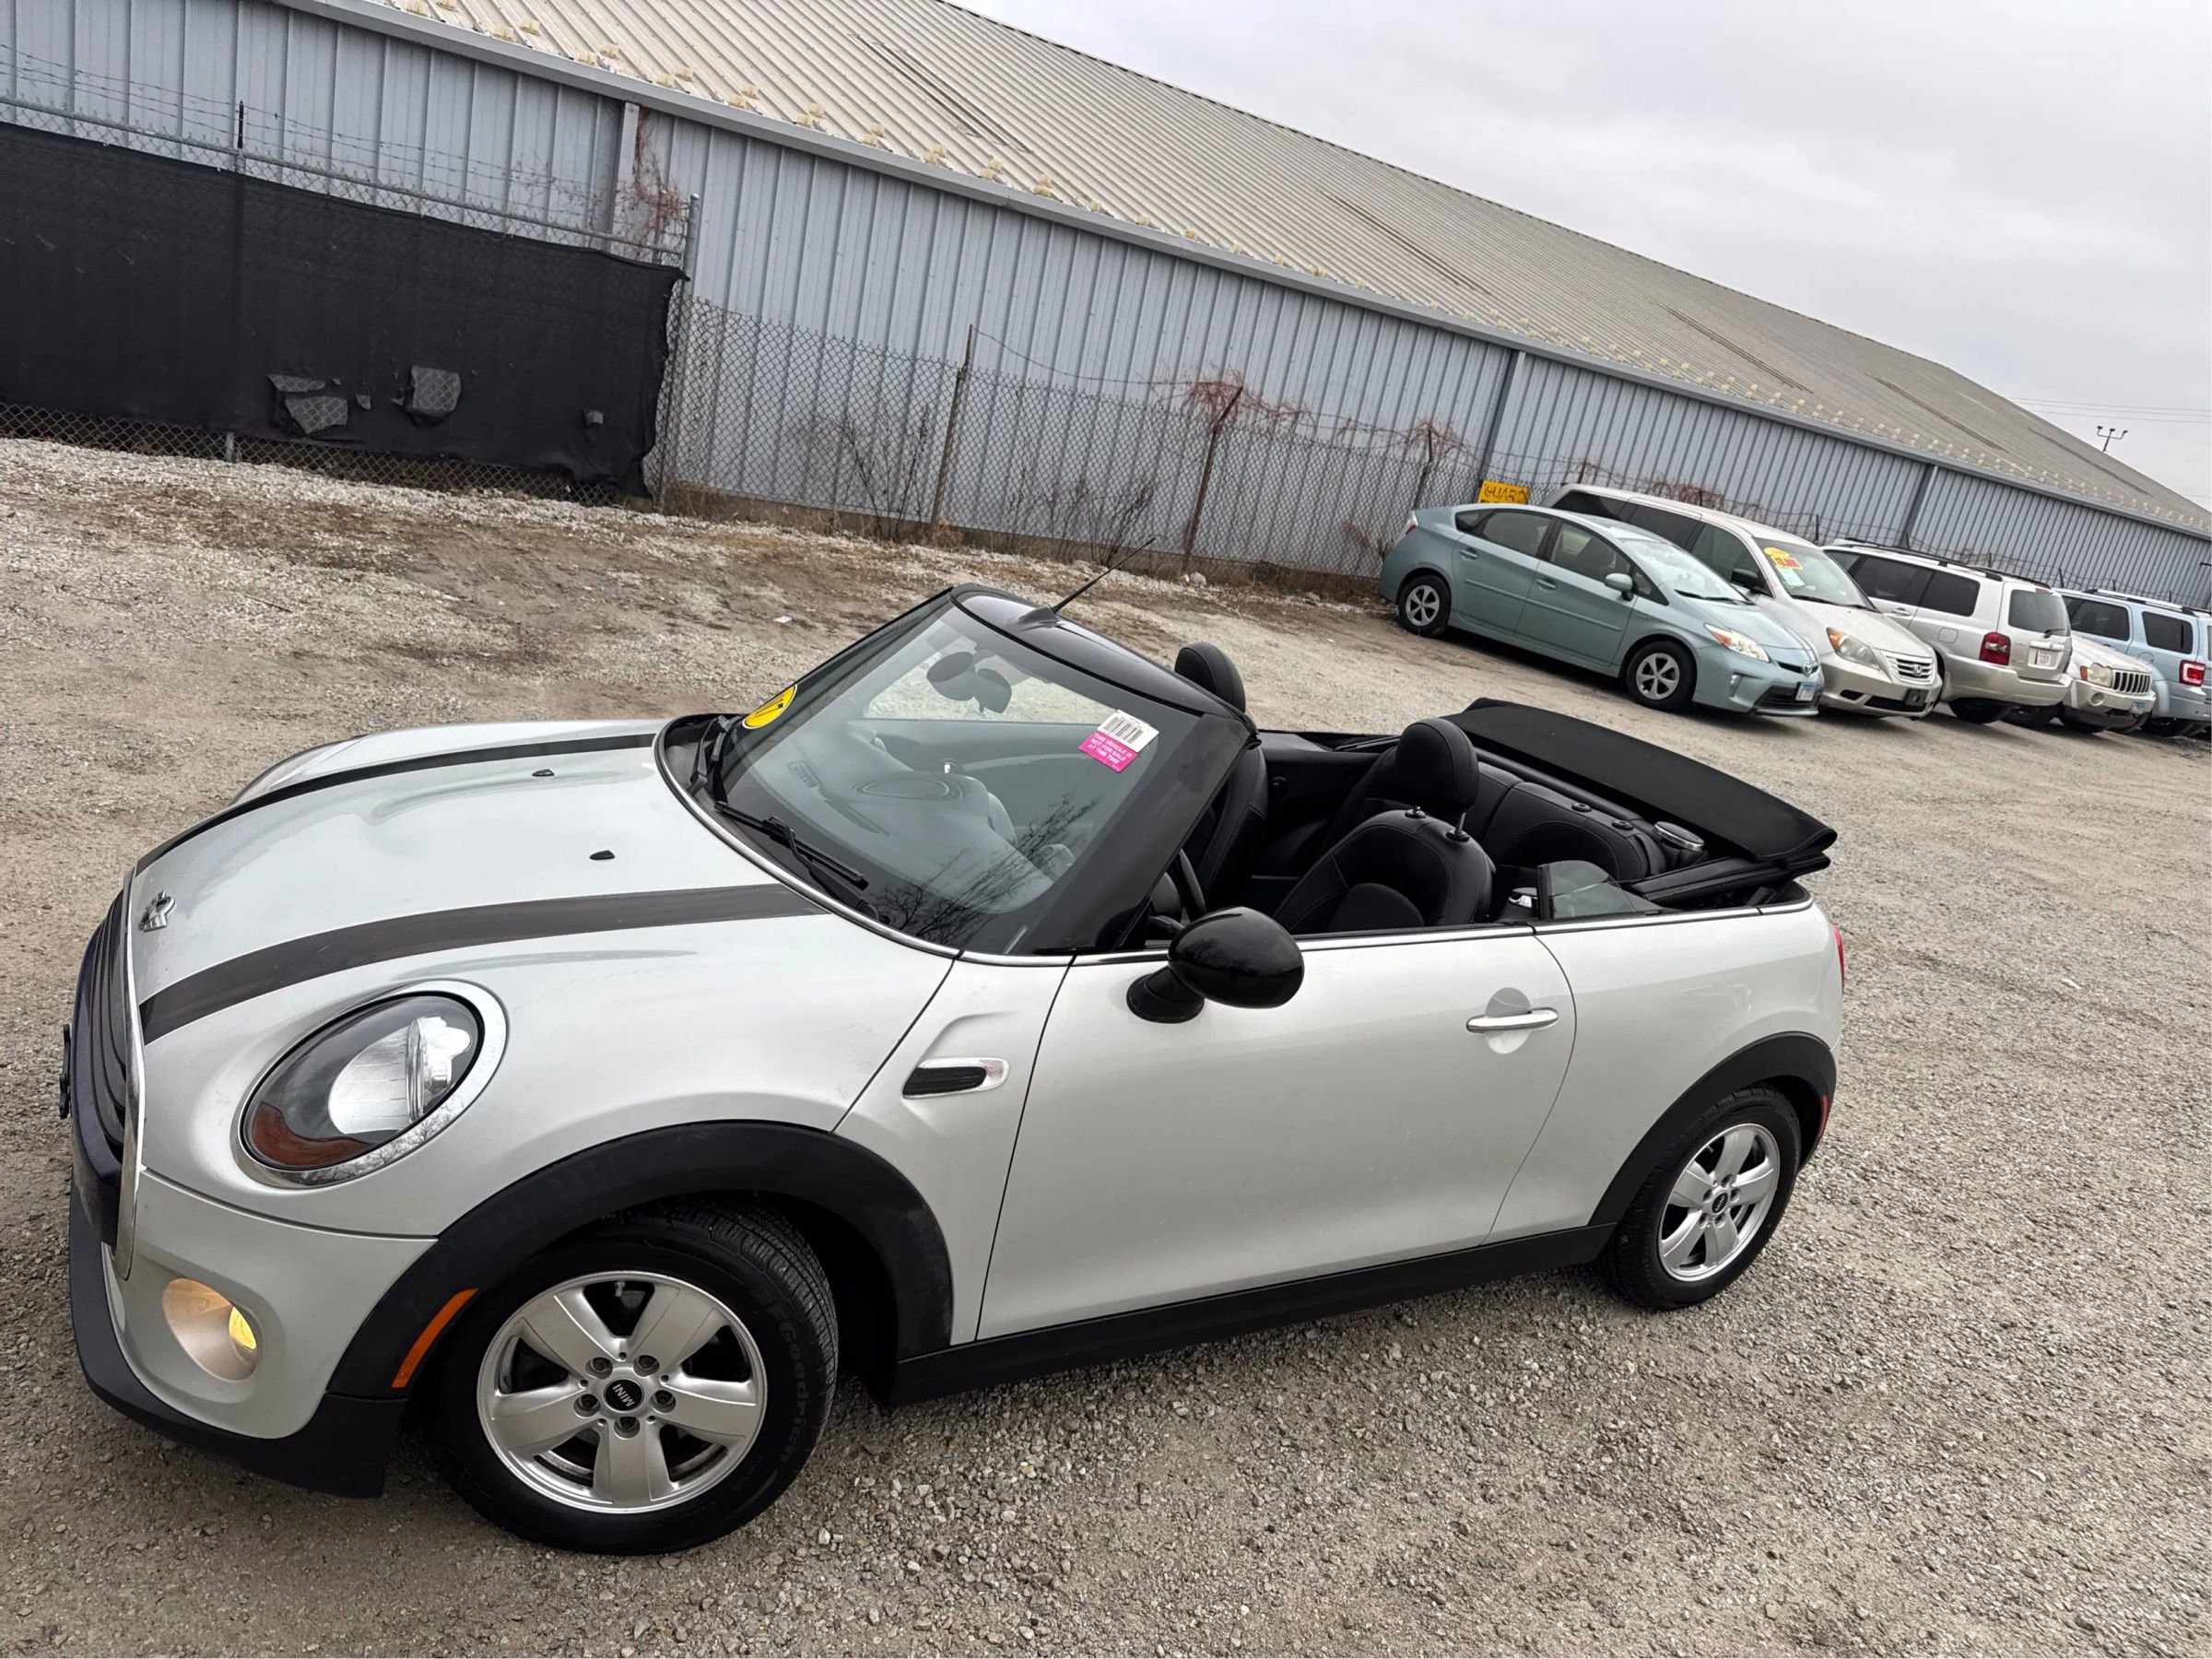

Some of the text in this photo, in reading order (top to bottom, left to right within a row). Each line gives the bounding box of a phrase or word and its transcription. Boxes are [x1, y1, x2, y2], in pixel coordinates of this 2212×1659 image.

[1100, 744, 1112, 753] FOR
[1112, 750, 1127, 760] SALE
[1106, 740, 1128, 754] VEHICLE
[1714, 1195, 1725, 1211] MINI
[612, 1383, 635, 1407] MINI
